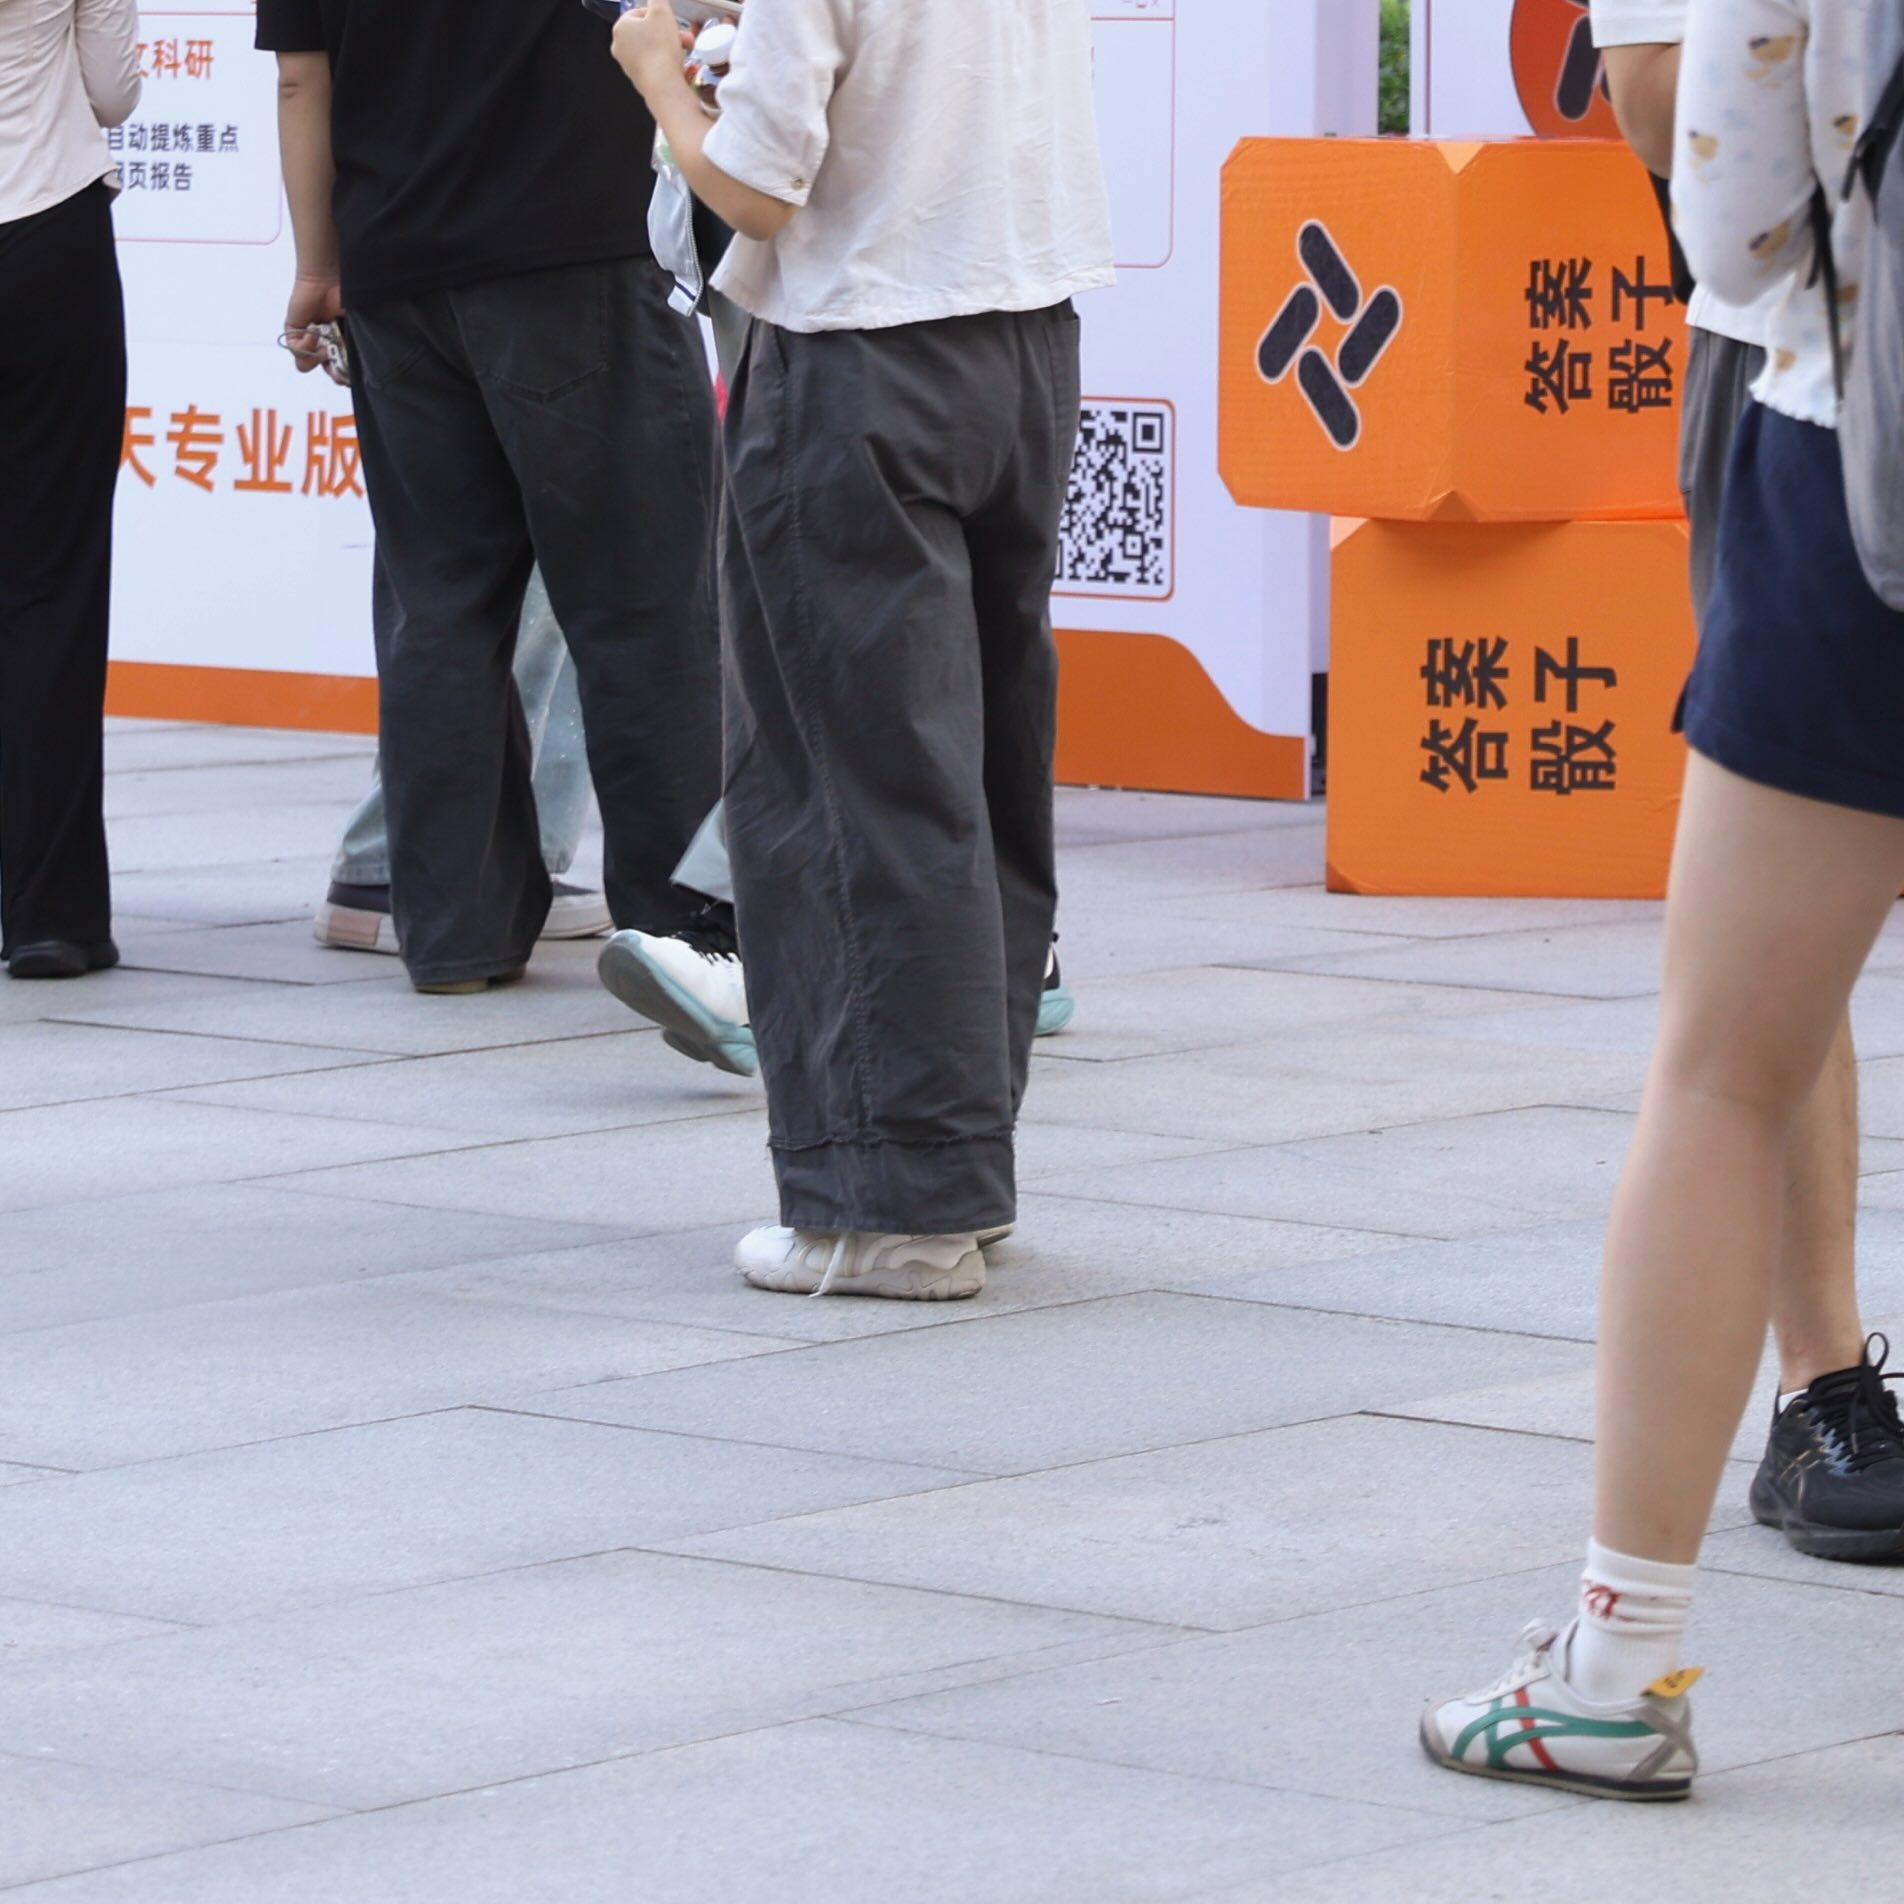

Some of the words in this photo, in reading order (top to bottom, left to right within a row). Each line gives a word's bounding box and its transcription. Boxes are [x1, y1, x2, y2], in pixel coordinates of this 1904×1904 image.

[1523, 254, 1594, 415] 答案
[1607, 254, 1676, 414] 骰子
[1419, 636, 1510, 795] 答案
[1529, 636, 1618, 795] 骰子
